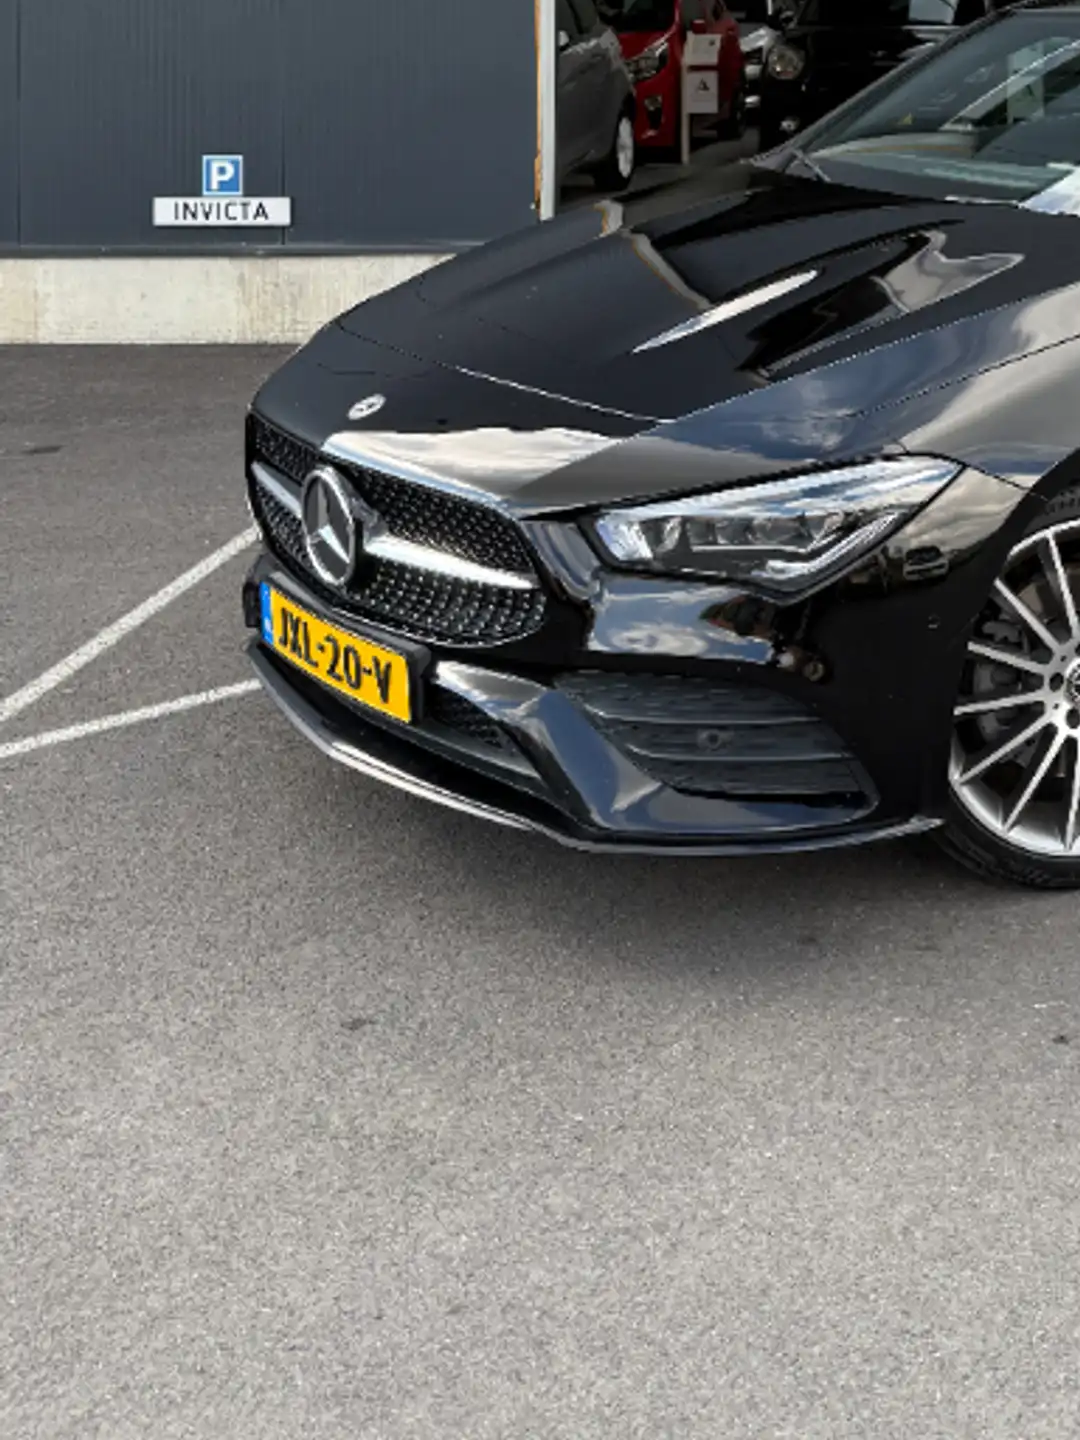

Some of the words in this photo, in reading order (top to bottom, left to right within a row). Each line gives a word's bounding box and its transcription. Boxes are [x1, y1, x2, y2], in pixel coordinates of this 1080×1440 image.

[210, 160, 235, 191] P
[174, 201, 269, 221] INVICTA
[279, 606, 392, 705] JXL-20-V
